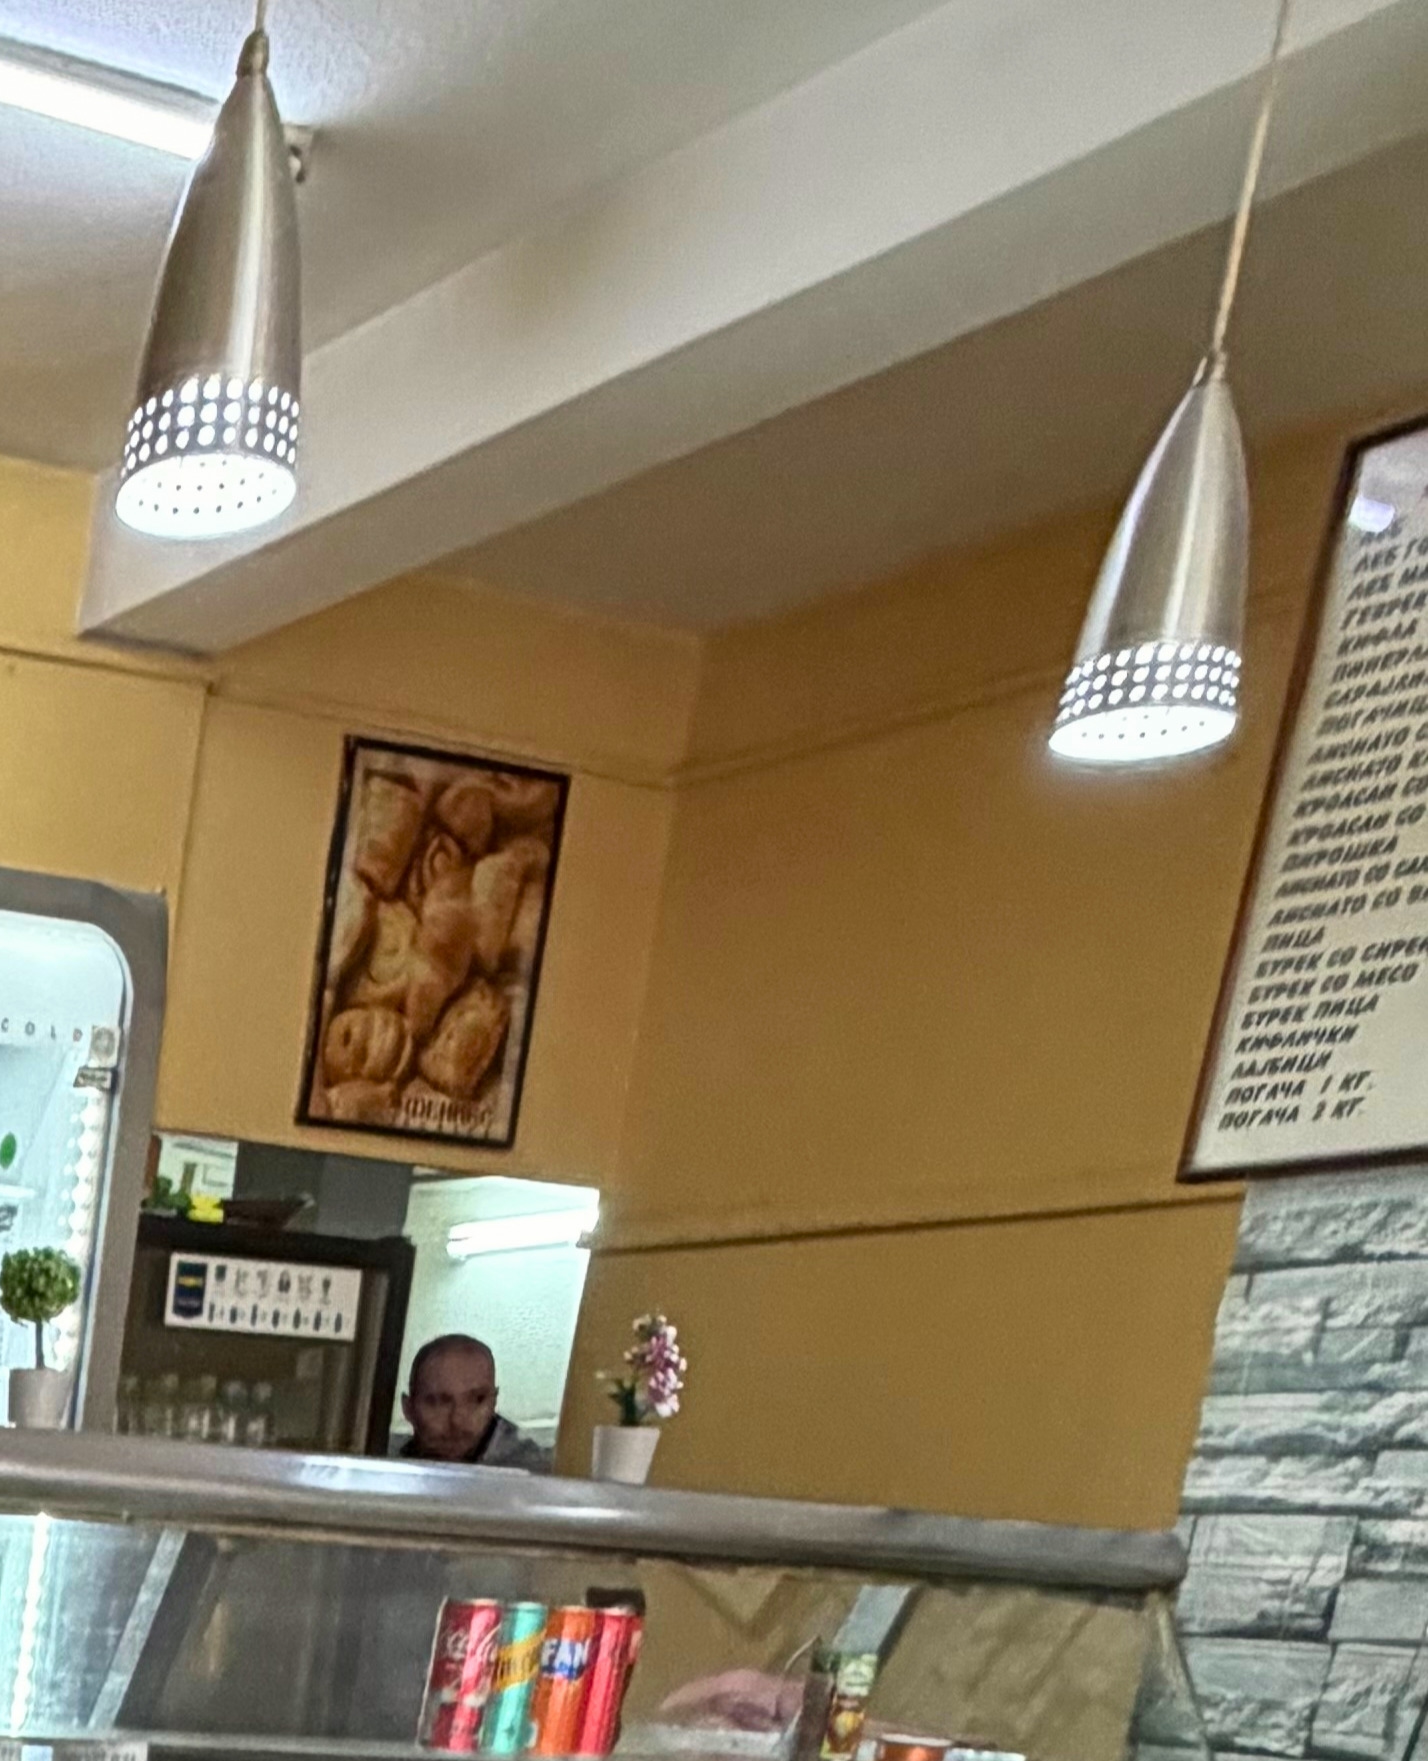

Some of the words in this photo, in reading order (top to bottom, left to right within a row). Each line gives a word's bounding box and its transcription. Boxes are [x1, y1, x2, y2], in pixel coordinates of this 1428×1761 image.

[1293, 782, 1397, 818] КРОАСАН
[1287, 811, 1392, 846] КРОАСАН
[1395, 803, 1426, 826] СО
[1281, 834, 1397, 872] ПИРОШКА
[1364, 863, 1391, 886] СО
[1267, 893, 1366, 927] ЛИСНАТО
[1371, 886, 1402, 911] СО
[1262, 926, 1324, 952] ПИЦА
[1255, 952, 1324, 978] БУРЕК
[1326, 947, 1356, 968] СО
[1248, 979, 1317, 1004] БУРЕК
[1320, 974, 1349, 994] СО
[1353, 963, 1419, 990] МЕСО
[1241, 1003, 1310, 1030] БУРЕК
[1313, 993, 1379, 1019] ПИЦА
[0, 1017, 84, 1043] COLD
[1235, 1024, 1359, 1052] КИФЛИЧКИ
[1225, 1079, 1305, 1106] ПОГАЧА
[1320, 1074, 1333, 1095] 1
[1218, 1105, 1299, 1131] ПОГАЧА
